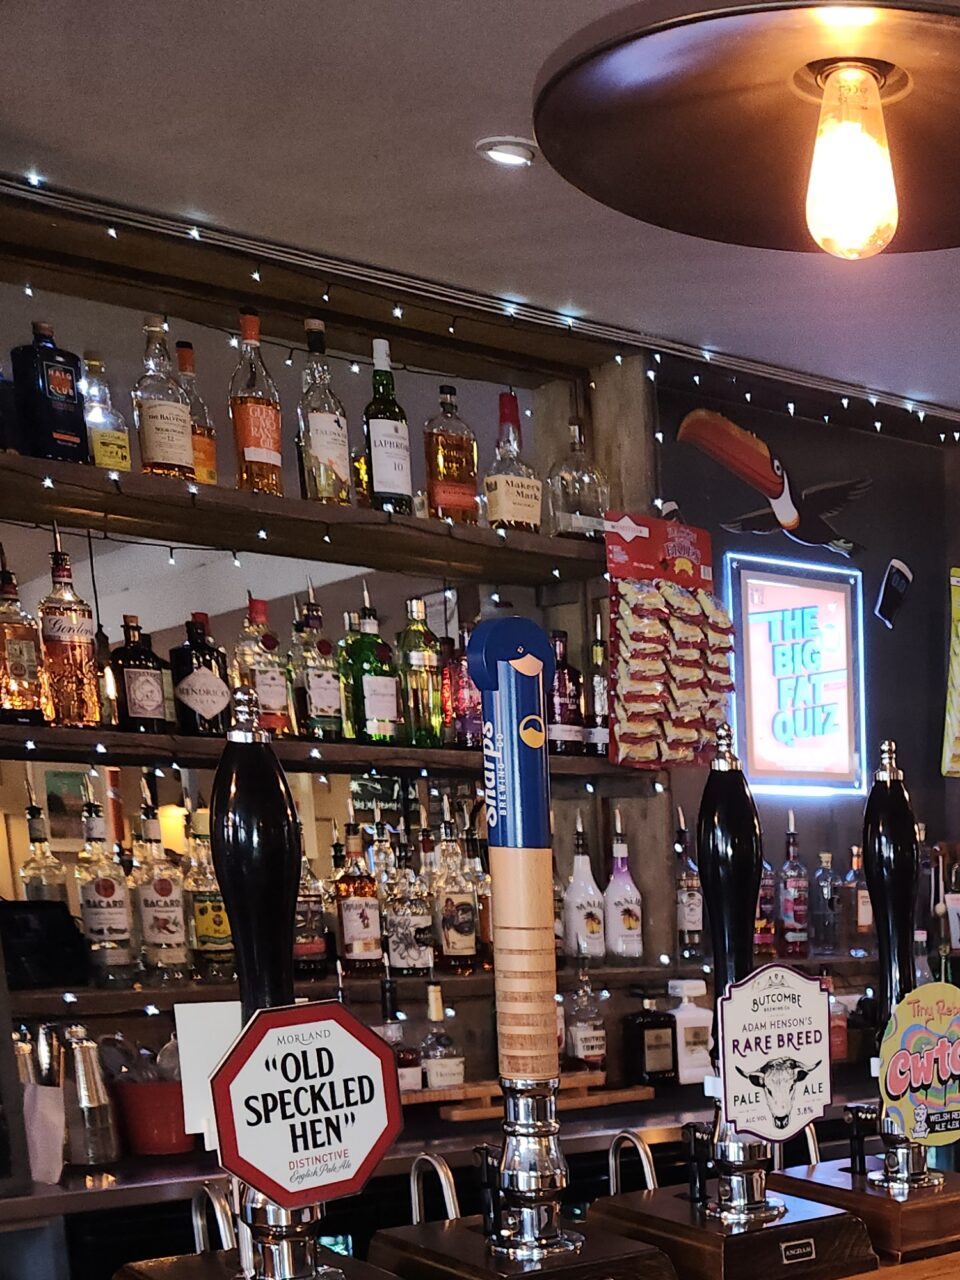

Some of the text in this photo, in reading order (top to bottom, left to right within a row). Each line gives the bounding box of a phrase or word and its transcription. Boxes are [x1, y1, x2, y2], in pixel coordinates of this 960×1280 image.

[47, 367, 73, 381] HAIG
[49, 384, 74, 397] CLUB
[514, 489, 540, 502] Mark
[748, 605, 821, 643] THE
[772, 639, 821, 677] BIG
[777, 669, 848, 710] FAT
[772, 702, 840, 748] QUIZ
[751, 993, 803, 1013] BUTCOMBE
[742, 1016, 813, 1033] ADAM HENSON'S
[277, 1029, 331, 1046] MORLAND
[732, 1029, 823, 1058] RARE BREED
[733, 1091, 761, 1107] PALE
[803, 1082, 824, 1096] ALE
[244, 1075, 375, 1127] SPECKLED
[929, 1111, 951, 1123] WELSH
[288, 1149, 350, 1171] DISTINCTIVE
[289, 1167, 319, 1184] English
[318, 1163, 338, 1178] Pale
